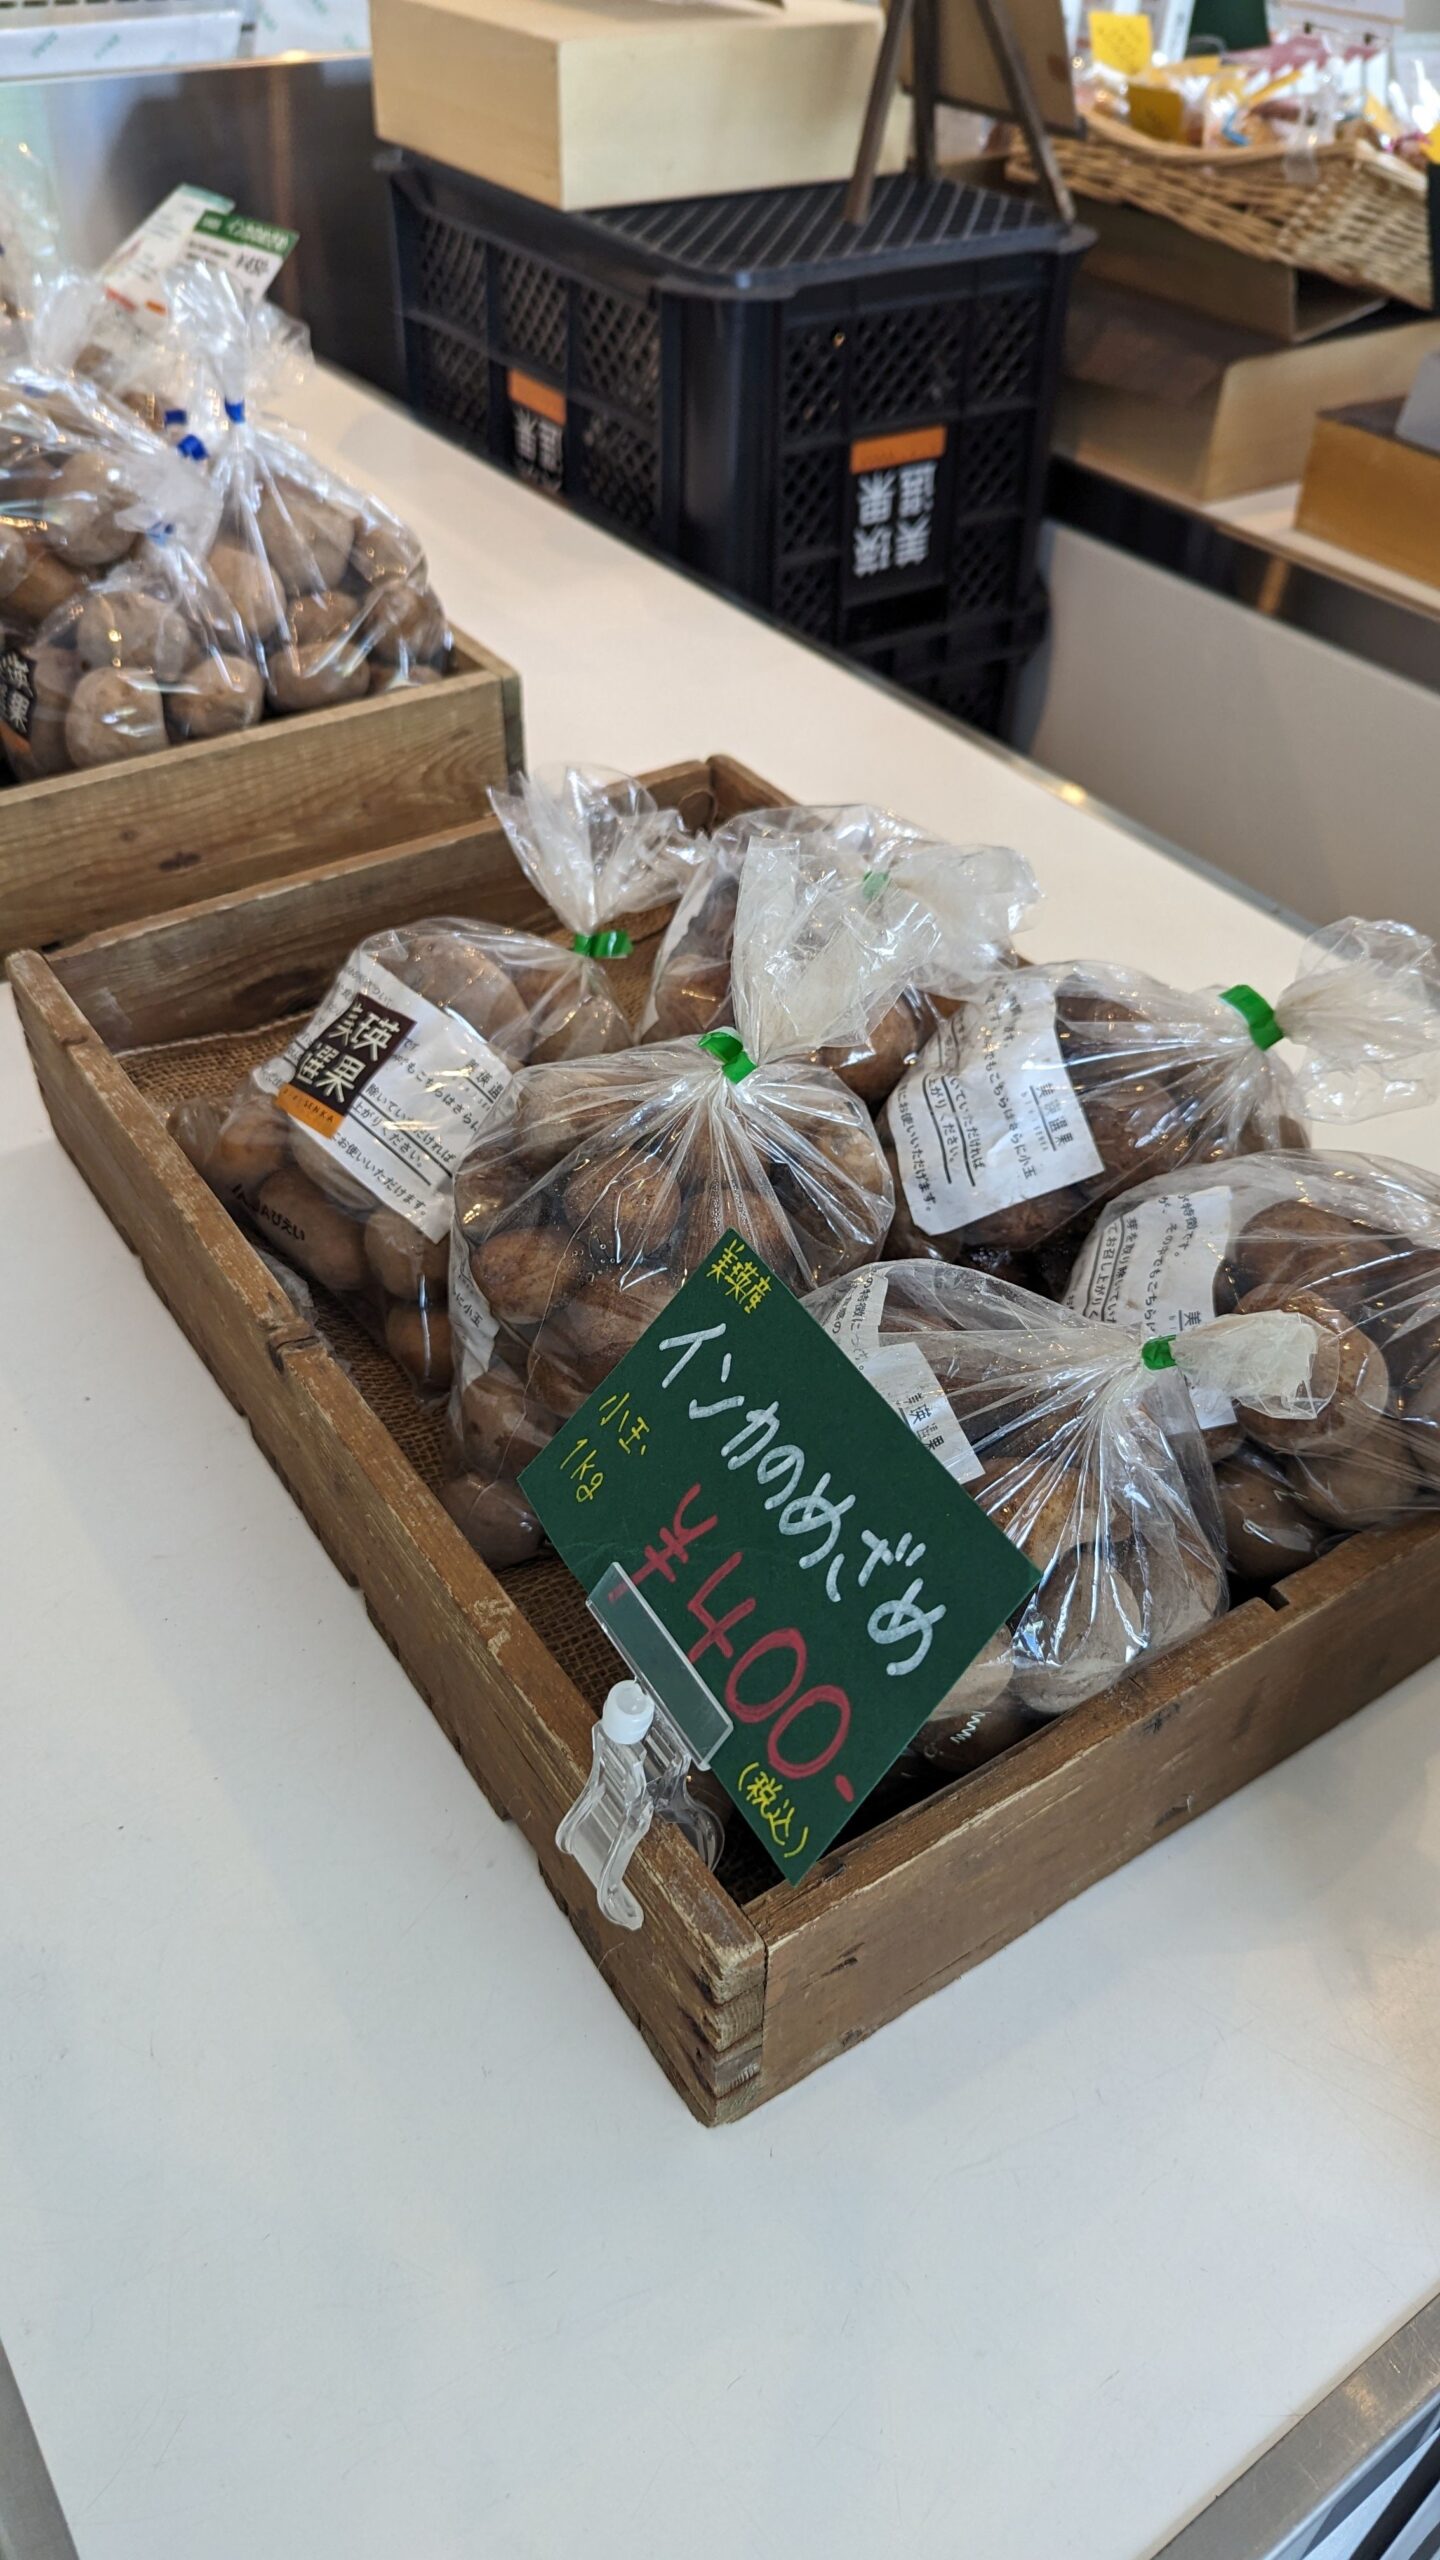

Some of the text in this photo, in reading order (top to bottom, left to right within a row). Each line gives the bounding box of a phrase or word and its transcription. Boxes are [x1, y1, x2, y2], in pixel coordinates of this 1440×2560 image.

[329, 1002, 400, 1061] 美瑛
[297, 1041, 367, 1104] 選果
[706, 1239, 771, 1314] 美瑛産
[599, 1391, 650, 1457] 小玉
[659, 1322, 947, 1676] インカのめざめ
[738, 1762, 809, 1858] (税込)
